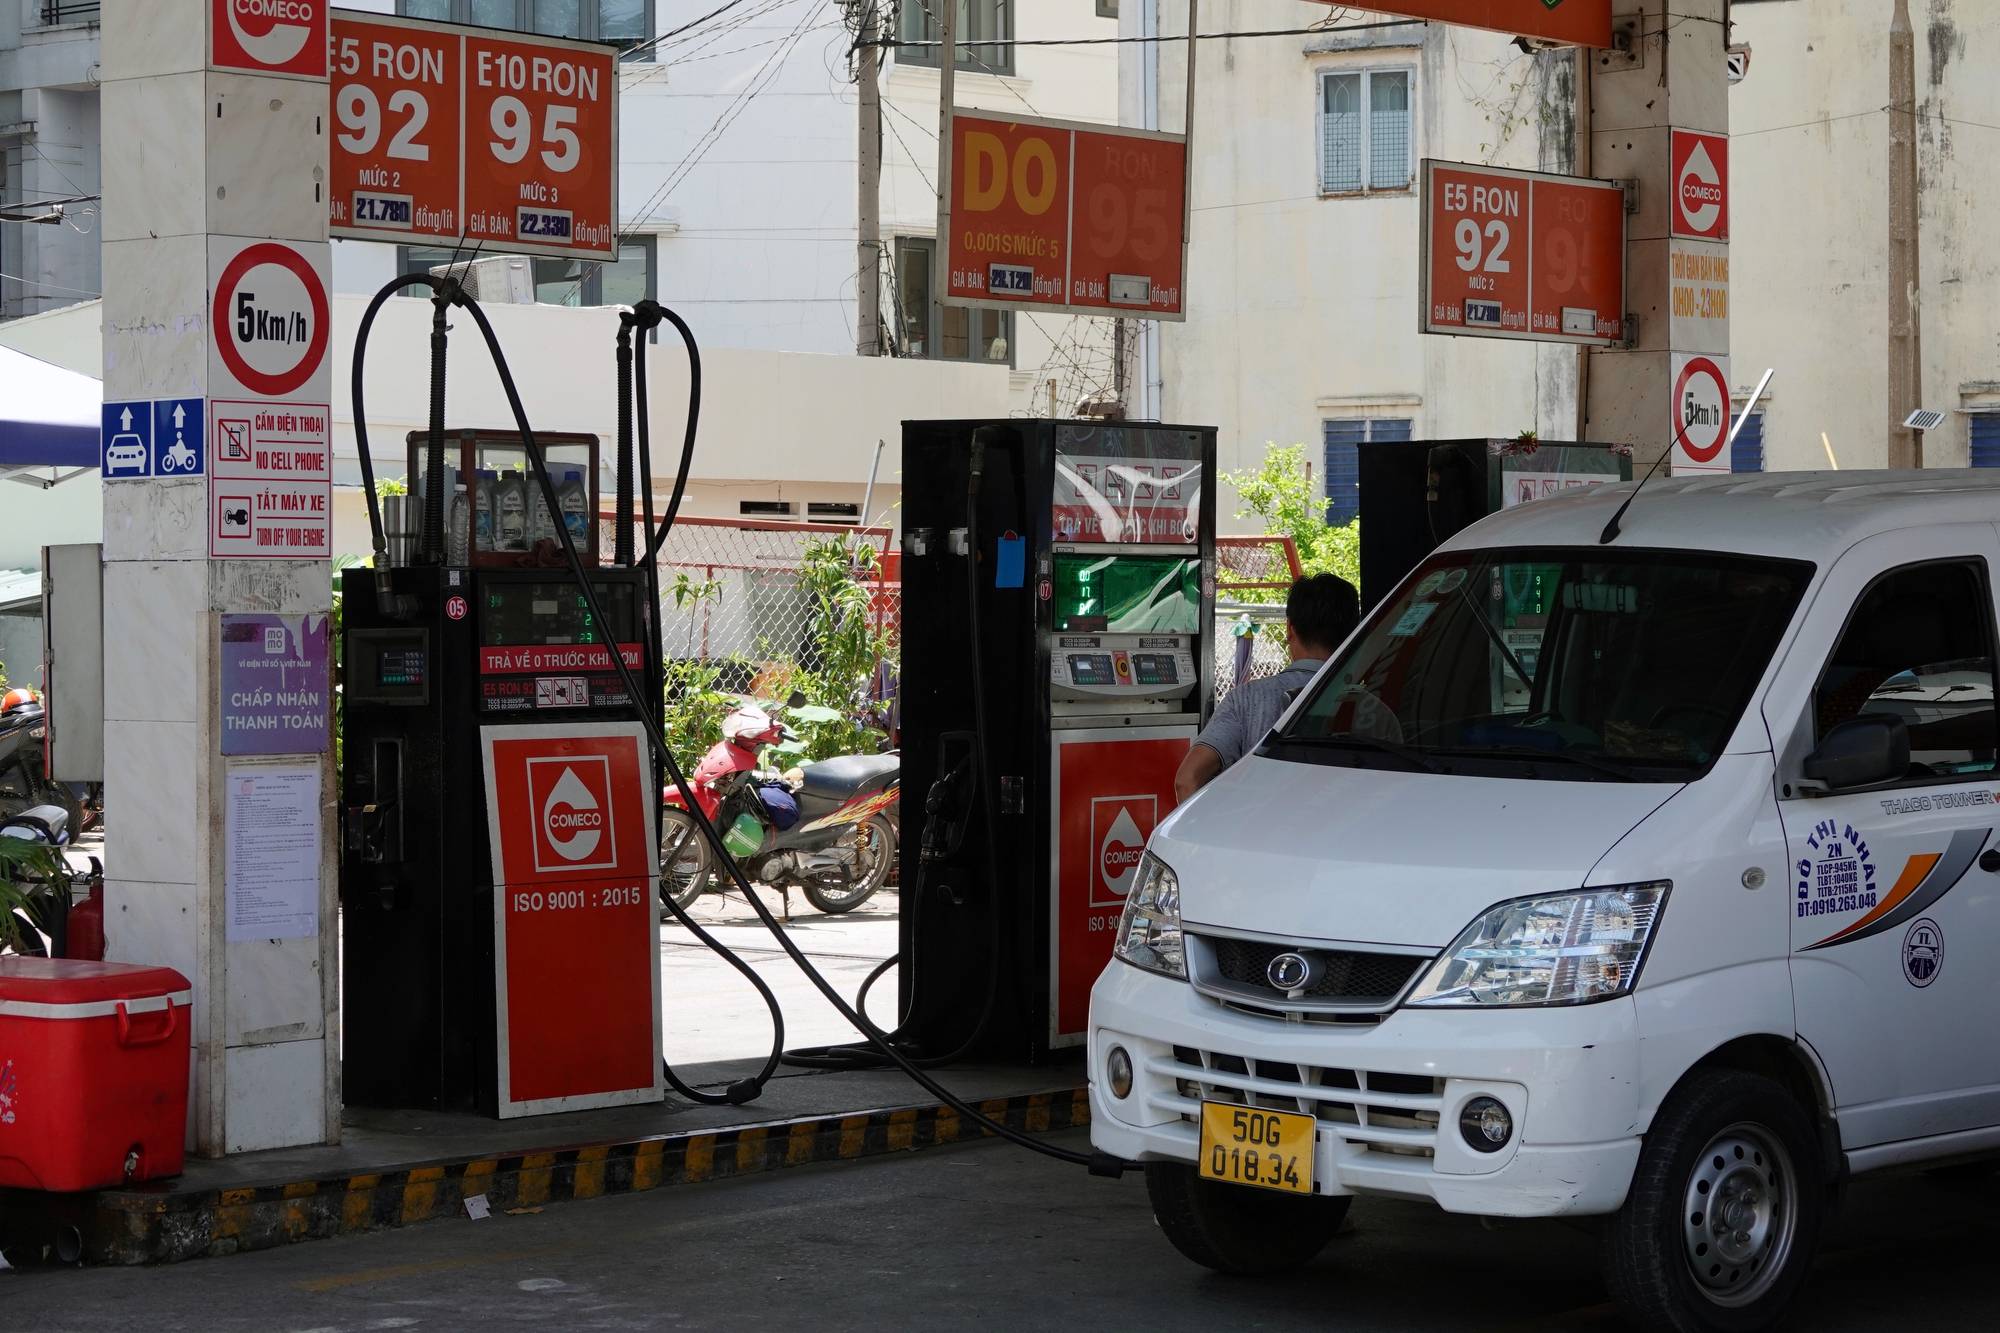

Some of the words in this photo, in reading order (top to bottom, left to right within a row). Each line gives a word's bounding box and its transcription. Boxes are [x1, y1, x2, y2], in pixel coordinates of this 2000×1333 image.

[236, 0, 313, 21] COMECO
[373, 42, 444, 84] RON
[477, 51, 526, 91] E10
[532, 57, 598, 101] RON
[336, 83, 429, 161] 92
[489, 95, 580, 173] 95
[359, 166, 389, 187] MỨC
[392, 172, 400, 188] 2
[520, 183, 547, 203] MỨC
[551, 187, 558, 203] 3
[1444, 182, 1467, 211] E5
[1473, 186, 1519, 217] RON
[1682, 184, 1722, 202] COMECO
[330, 196, 347, 221] ÁN:
[356, 197, 410, 223] 21.780
[416, 208, 453, 232] đồng/lít
[470, 212, 487, 234] GIÁ
[490, 212, 512, 236] BÁN:
[520, 213, 570, 238] 22.330
[575, 221, 610, 246] đồng/lít
[1050, 240, 1059, 259] 5
[1454, 218, 1510, 274] 92
[953, 268, 965, 288] GIÁ
[968, 269, 985, 290] BÁN:
[1034, 276, 1062, 299] đồng/lít
[1074, 278, 1087, 298] GIÁ
[1088, 279, 1105, 299] BÁN:
[1151, 285, 1178, 307] đồng/lít
[1469, 274, 1487, 291] MỨC
[1489, 278, 1495, 291] 2
[1700, 287, 1727, 320] 23H00
[1434, 303, 1446, 321] GIÁ
[1447, 304, 1462, 323] BÁN:
[1502, 309, 1526, 330] đồng/lít
[1533, 311, 1545, 328] GIÁ
[1545, 312, 1559, 330] BÁN:
[1597, 317, 1619, 336] đồng/lít
[255, 410, 275, 433] CẤM
[276, 412, 297, 436] ĐIỆN
[299, 415, 324, 437] THOẠI
[255, 450, 268, 470] NO
[271, 451, 293, 471] CELL
[295, 452, 324, 471] PHONE
[256, 487, 278, 511] TẮT
[281, 490, 306, 512] MÁY
[310, 494, 325, 511] XE
[256, 527, 272, 547] TURN
[272, 528, 284, 547] OFF
[285, 528, 302, 547] YOUR
[303, 529, 325, 547] ENGINE
[1150, 518, 1167, 535] KHI
[1040, 583, 1050, 598] 07
[449, 600, 464, 617] 05
[487, 652, 513, 669] TRẢ
[515, 650, 532, 668] VỀ
[534, 655, 541, 668] 0
[545, 650, 586, 667] TRƯỚC
[588, 652, 609, 666] KHI
[231, 686, 272, 707] CHẤP
[276, 689, 319, 710] NHẬN
[483, 683, 497, 696] E5
[498, 682, 521, 695] RON
[522, 682, 534, 695] 92
[226, 715, 278, 730] THANH
[282, 711, 324, 730] TOÁN
[1880, 796, 1932, 815] THACO
[1932, 790, 1994, 810] TOWNER
[550, 812, 601, 828] COMECO
[1827, 843, 1843, 858] 2N
[1816, 860, 1857, 876] TLCP:945KG
[1817, 872, 1857, 887] TLBT:1040KG
[514, 892, 543, 912] ISO
[548, 890, 585, 909] 9001
[602, 887, 640, 906] 2015
[1817, 883, 1858, 898] TLTB:2115KG
[1797, 892, 1877, 918] ĐT:0919.263.048
[1089, 916, 1105, 932] ISO
[1918, 932, 1932, 945] TL
[1233, 1110, 1281, 1147] 50G
[1212, 1144, 1298, 1188] 018.34
